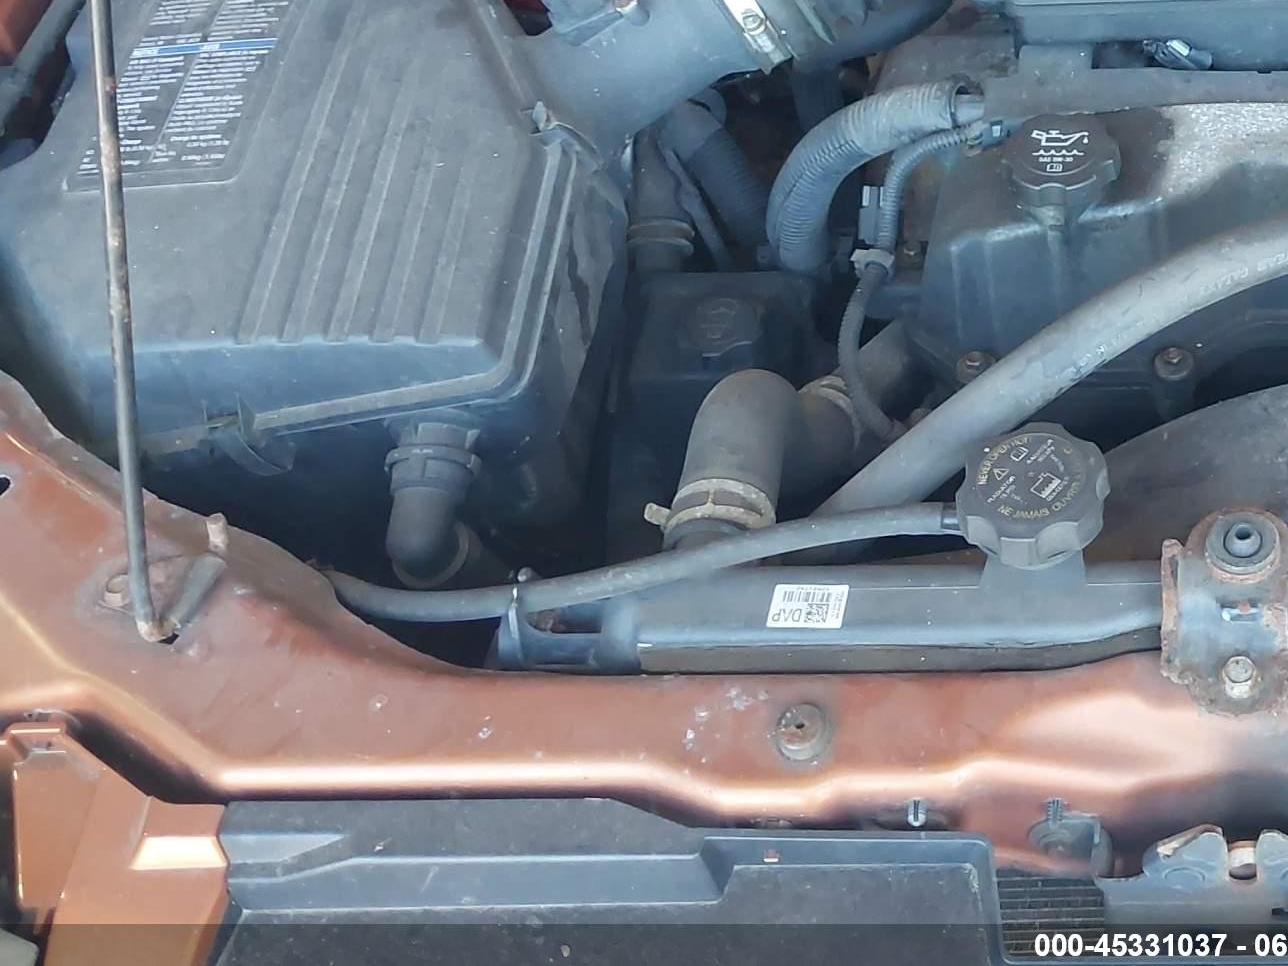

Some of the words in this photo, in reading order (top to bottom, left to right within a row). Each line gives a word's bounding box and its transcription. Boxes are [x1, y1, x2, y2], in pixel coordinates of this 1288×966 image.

[997, 505, 1014, 516] NE
[1012, 507, 1050, 519] JAMAIS
[771, 608, 803, 622] DAP
